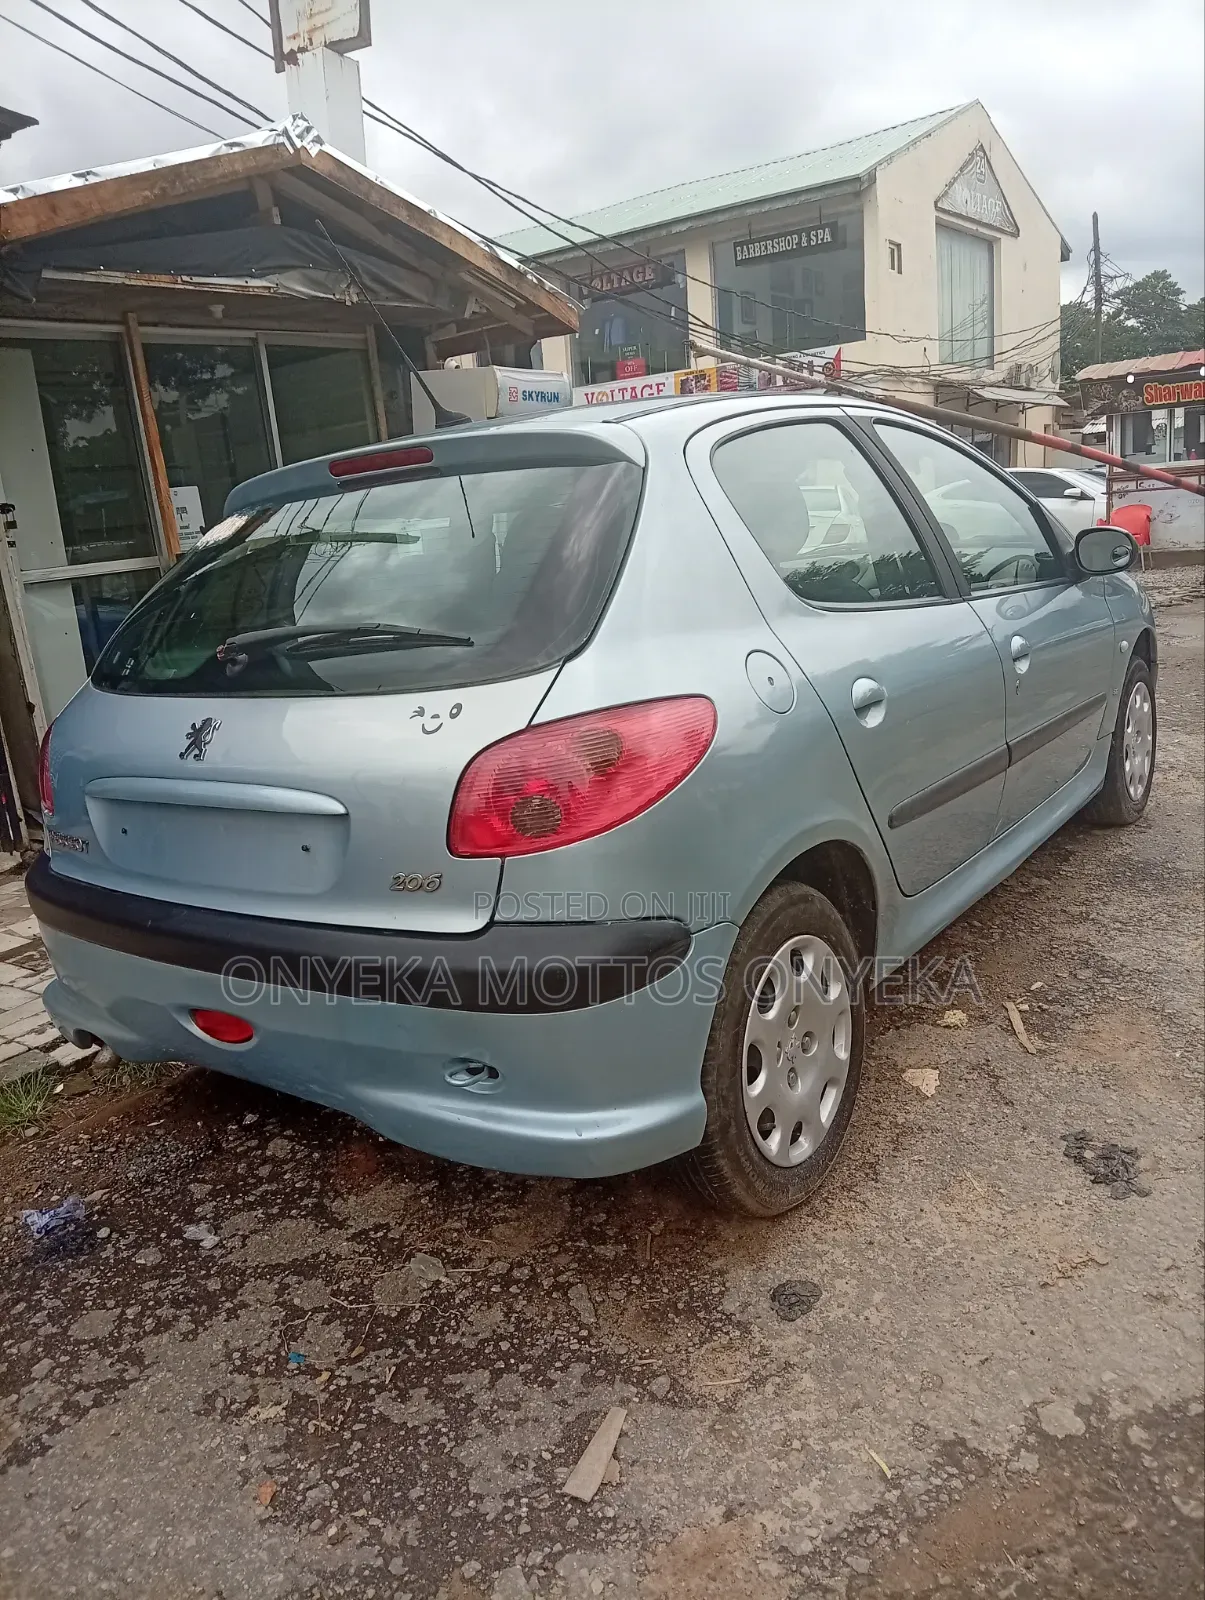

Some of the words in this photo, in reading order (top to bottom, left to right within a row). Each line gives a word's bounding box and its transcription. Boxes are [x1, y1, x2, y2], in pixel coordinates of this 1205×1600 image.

[736, 234, 799, 261] BARBERSHOP
[801, 232, 809, 248] &
[810, 227, 833, 246] SPA
[521, 390, 560, 403] SKYRUN
[1143, 381, 1205, 405] Sharwa
[389, 872, 442, 892] 206
